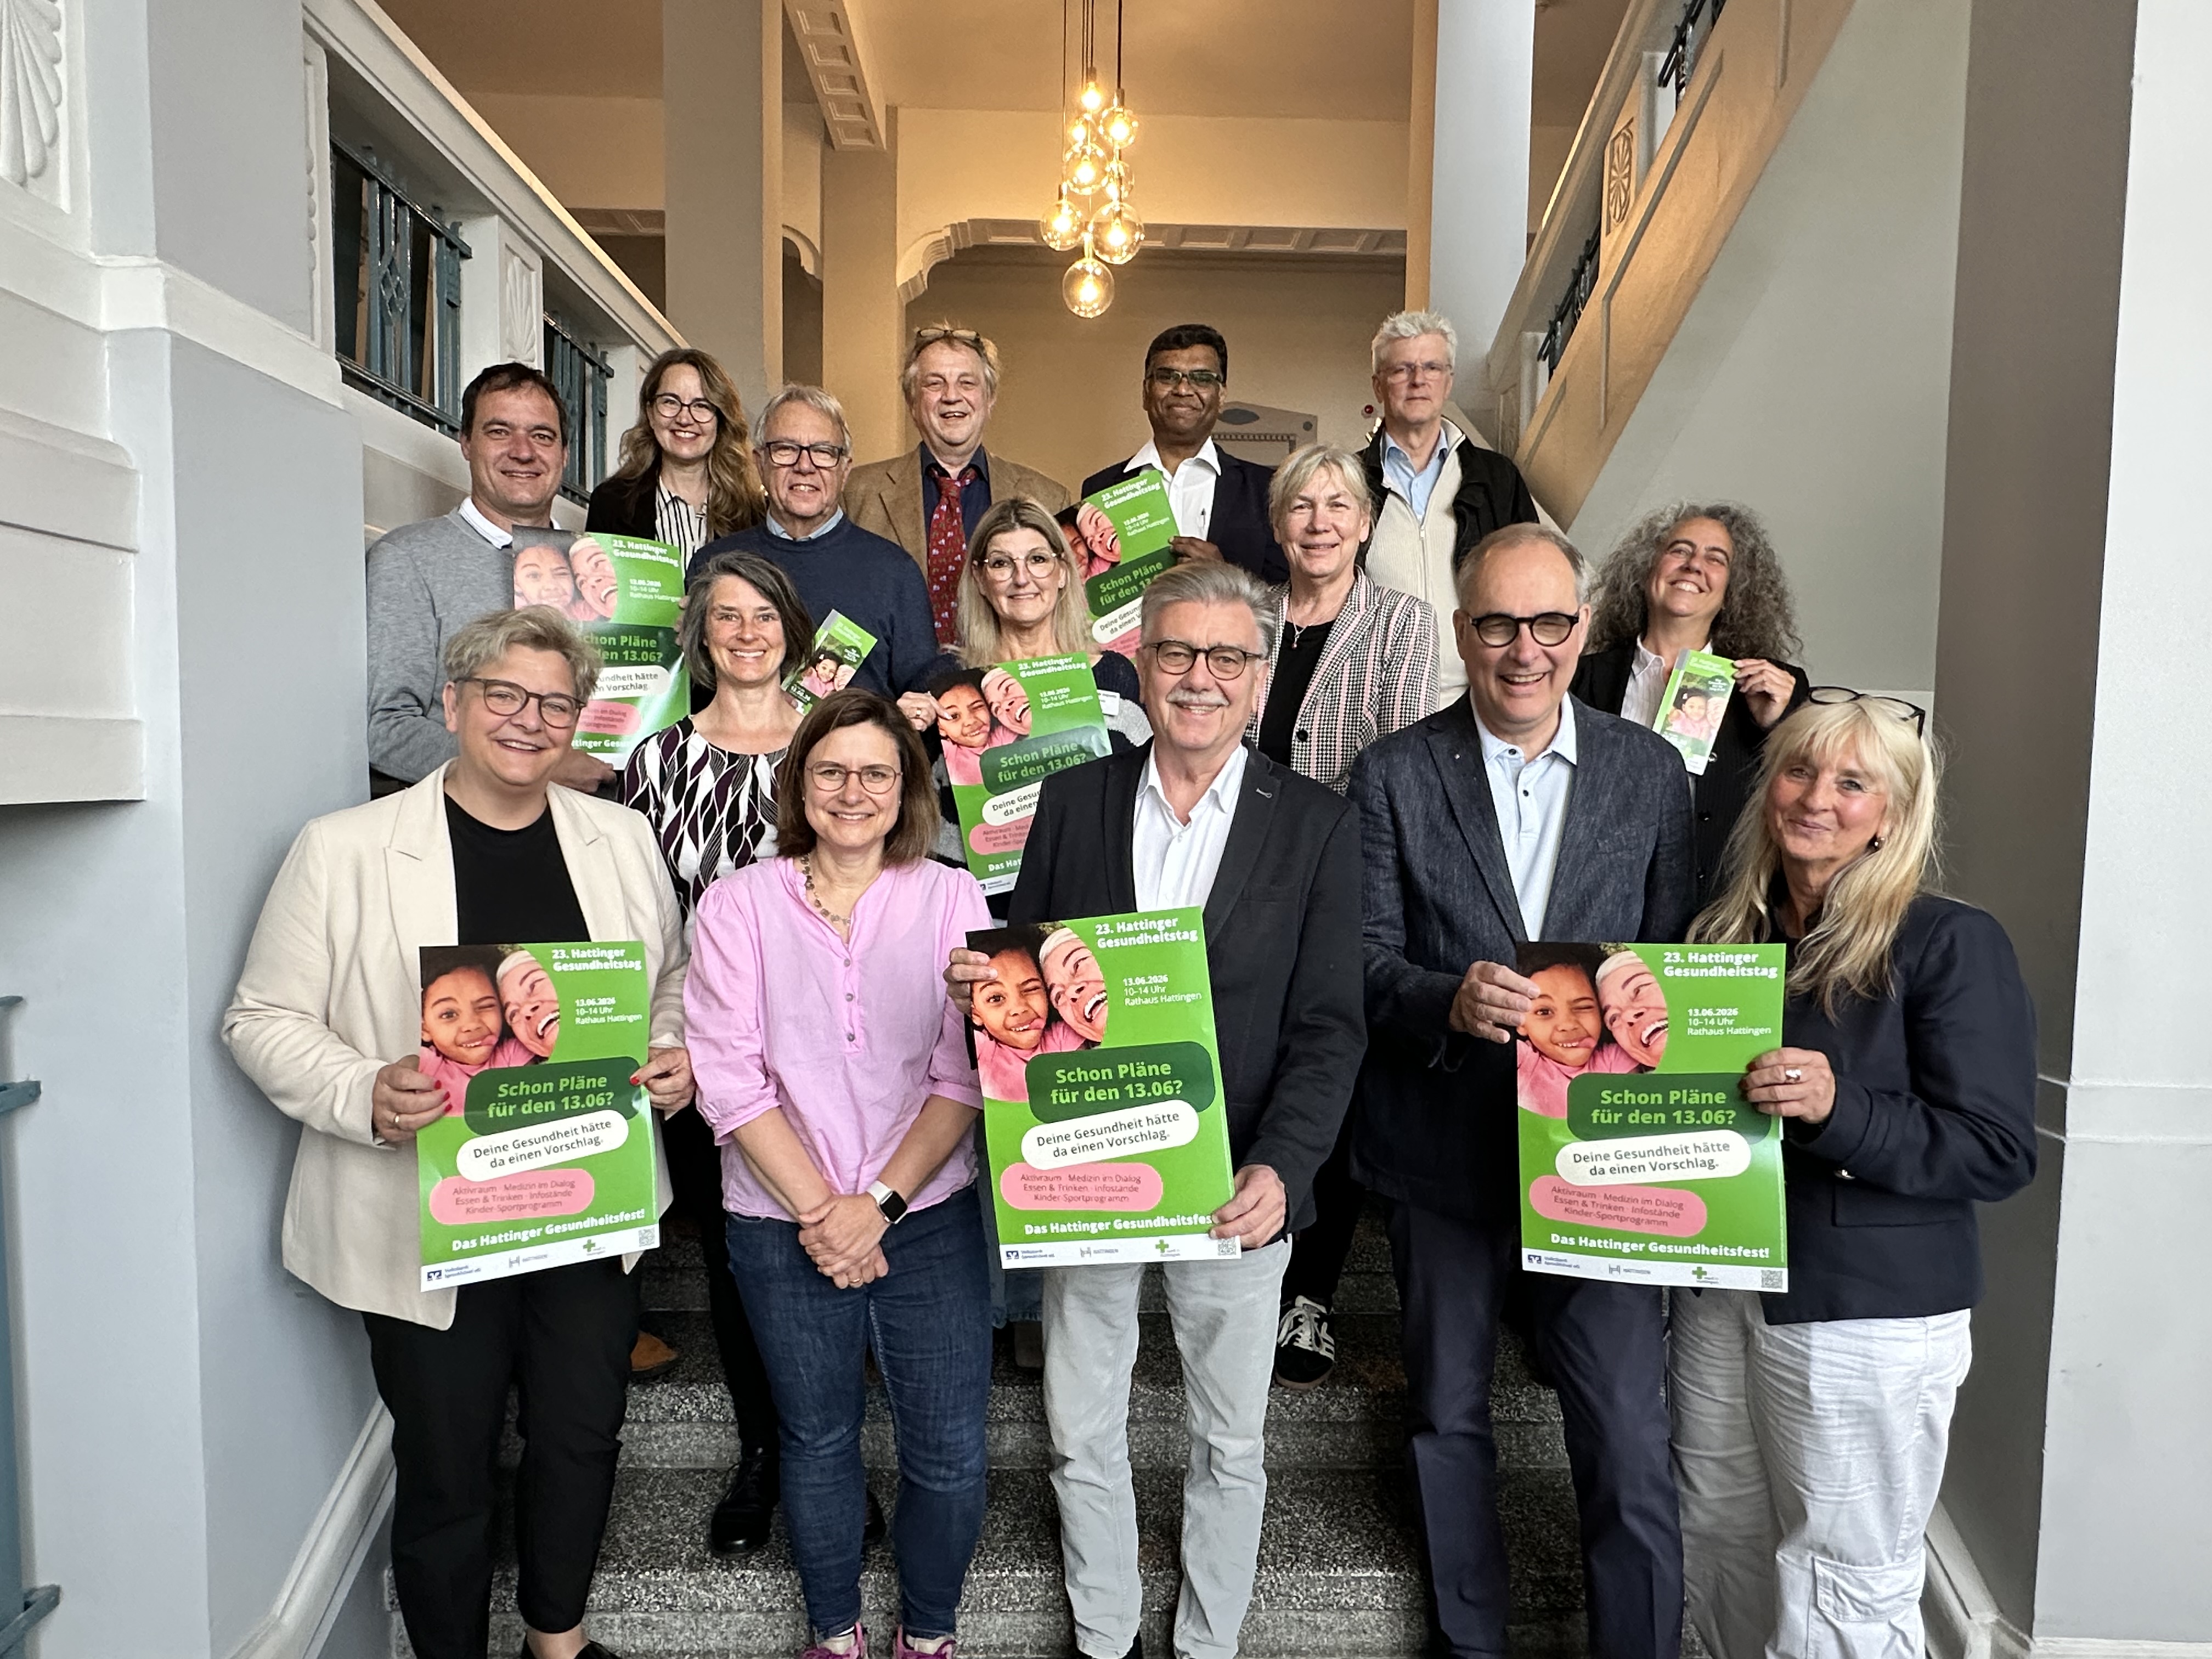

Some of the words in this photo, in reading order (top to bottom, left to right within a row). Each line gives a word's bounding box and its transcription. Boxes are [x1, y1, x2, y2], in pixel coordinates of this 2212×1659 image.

[627, 541, 667, 554] Hattinger
[613, 549, 679, 567] Gesundheitstag
[1099, 575, 1132, 592] Schon
[1132, 562, 1163, 579] Pläne
[1099, 594, 1116, 606] für
[1118, 585, 1138, 598] den
[1100, 618, 1118, 631] Deine
[1119, 616, 1136, 629] einen
[583, 632, 616, 646] chon
[620, 635, 657, 647] Pläne
[623, 650, 663, 662] 13.06?
[1032, 657, 1073, 668] Hattinger
[1020, 663, 1087, 678] Gesundheitstag
[1000, 752, 1039, 768] Schon
[1042, 743, 1077, 758] Pläne
[997, 770, 1017, 782] für
[1020, 765, 1045, 777] den
[1048, 753, 1086, 770] 13.06?
[992, 799, 1016, 811] Deine
[988, 862, 1005, 872] Das
[1095, 923, 1114, 935] 23.
[1116, 918, 1178, 933] Hattinger
[1097, 930, 1198, 948] Gesundheitstag
[552, 949, 569, 959] 23.
[571, 948, 625, 959] Hattinger
[1663, 952, 1685, 963] 23.
[1688, 952, 1759, 966] Hattinger
[553, 960, 642, 972] Gesundheitstag
[1663, 966, 1778, 979] Gesundheitstag
[1124, 974, 1169, 986] 13.06.2026
[1151, 985, 1166, 994] Uhr
[575, 997, 616, 1006] 13.06.2026
[1125, 996, 1159, 1006] Rathaus
[1160, 992, 1202, 1003] Hattingen
[575, 1016, 606, 1025] Rathaus
[607, 1014, 643, 1023] Hattingen
[1688, 1008, 1738, 1016] 13.06.2026
[1688, 1028, 1724, 1036] Rathaus
[1726, 1026, 1771, 1036] Hattingen
[1056, 1066, 1113, 1084] Schon
[1118, 1062, 1171, 1079] Pläne
[498, 1082, 554, 1097] Schon
[558, 1075, 607, 1091] Pläne
[1051, 1088, 1079, 1104] für
[1084, 1086, 1119, 1102] den
[1125, 1080, 1183, 1098] 13.06?
[488, 1102, 516, 1118] für
[521, 1099, 555, 1115] den
[561, 1092, 614, 1110] 13.06?
[1601, 1090, 1662, 1105] Schon
[1669, 1089, 1726, 1104] Pläne
[1591, 1109, 1622, 1124] für
[1628, 1109, 1666, 1124] den
[1673, 1110, 1736, 1125] 13.06?
[1037, 1133, 1070, 1147] Deine
[1075, 1118, 1143, 1139] Gesundheit
[1146, 1113, 1180, 1126] hätte
[473, 1144, 509, 1159] Deine
[512, 1128, 578, 1149] Gesundheit
[582, 1120, 611, 1132] hätte
[1053, 1148, 1068, 1158] da
[1071, 1140, 1104, 1154] einen
[1106, 1129, 1170, 1148] Vorschlag.
[490, 1158, 505, 1168] da
[509, 1150, 541, 1164] einen
[544, 1136, 603, 1155] Vorschlag.
[1573, 1152, 1611, 1163] Deine
[1614, 1144, 1690, 1160] Gesundheit
[1694, 1142, 1730, 1154] hätte
[1590, 1166, 1605, 1176] da
[1610, 1163, 1646, 1174] einen
[1649, 1158, 1718, 1172] Vorschlag.
[1115, 1174, 1141, 1184] Dialog
[453, 1186, 497, 1195] Aktivraum
[551, 1180, 575, 1188] Dialog
[455, 1197, 480, 1205] Essen
[492, 1193, 523, 1201] Trinken
[1551, 1186, 1596, 1199] Aktivraum
[1604, 1193, 1639, 1204] Medizin
[1641, 1195, 1652, 1205] im
[1655, 1199, 1684, 1211] Dialog
[1554, 1195, 1579, 1206] Essen
[1591, 1200, 1624, 1211] Trinken
[1632, 1207, 1680, 1218] Infostände
[1025, 1223, 1047, 1234] Das
[1050, 1220, 1111, 1234] Hattinger
[1114, 1214, 1212, 1230] Gesundheitsfes
[1564, 1207, 1668, 1227] Kinder-Sportprogramm
[452, 1239, 477, 1251] Das
[480, 1228, 543, 1246] Hattinger
[545, 1209, 645, 1234] Gesundheitsfest!
[1550, 1233, 1576, 1245] Das
[1579, 1236, 1645, 1253] Hattinger
[1648, 1242, 1770, 1259] Gesundheitsfest!
